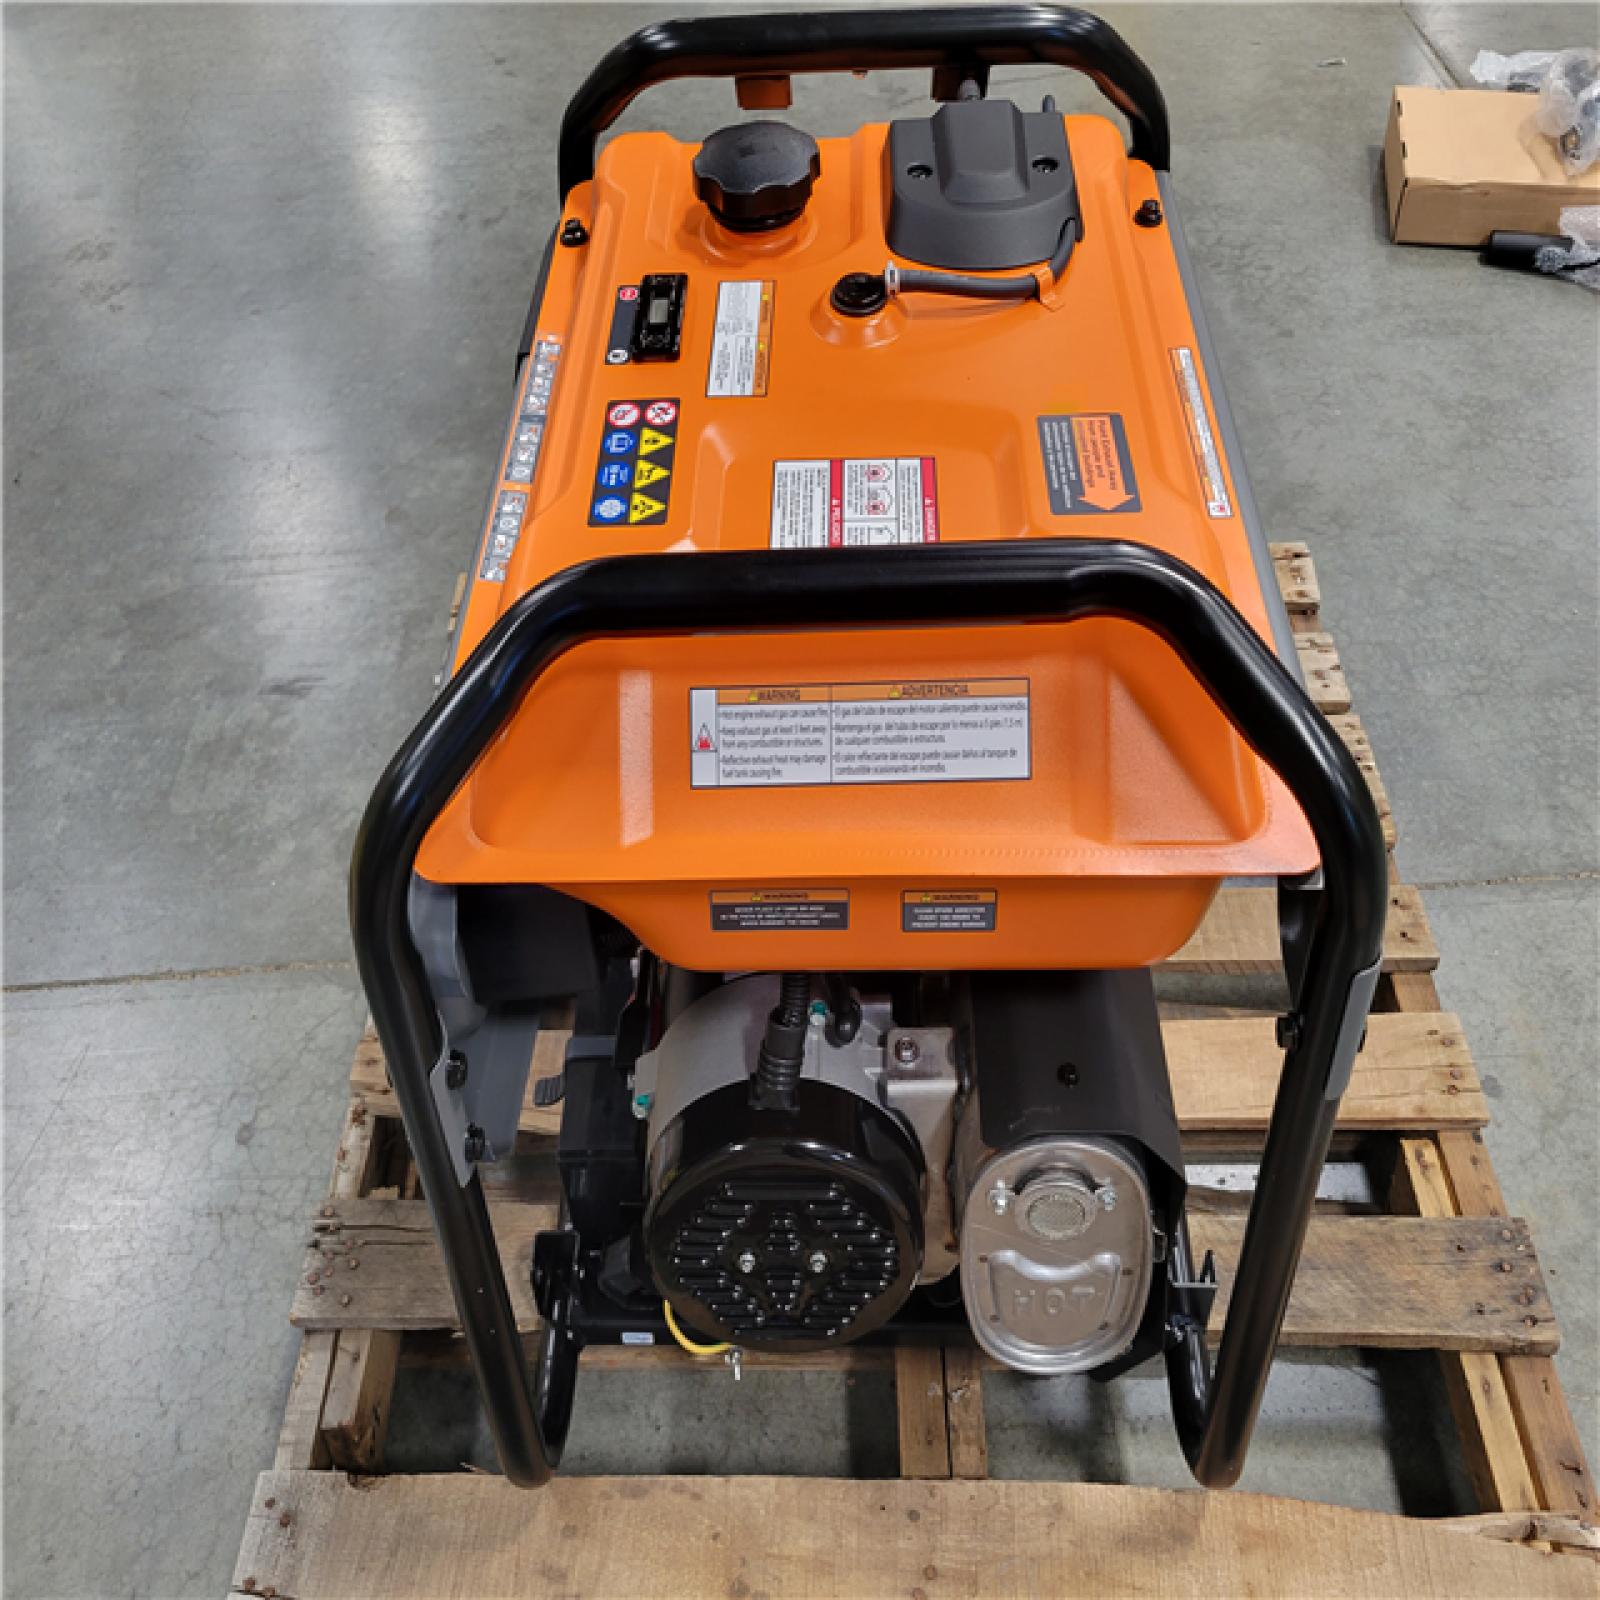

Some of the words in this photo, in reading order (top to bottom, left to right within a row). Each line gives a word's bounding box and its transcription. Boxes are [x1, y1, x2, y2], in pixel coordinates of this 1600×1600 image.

[758, 688, 800, 700] WARNING
[902, 684, 968, 696] ADVERTENCIA
[1012, 1286, 1096, 1314] HOT
